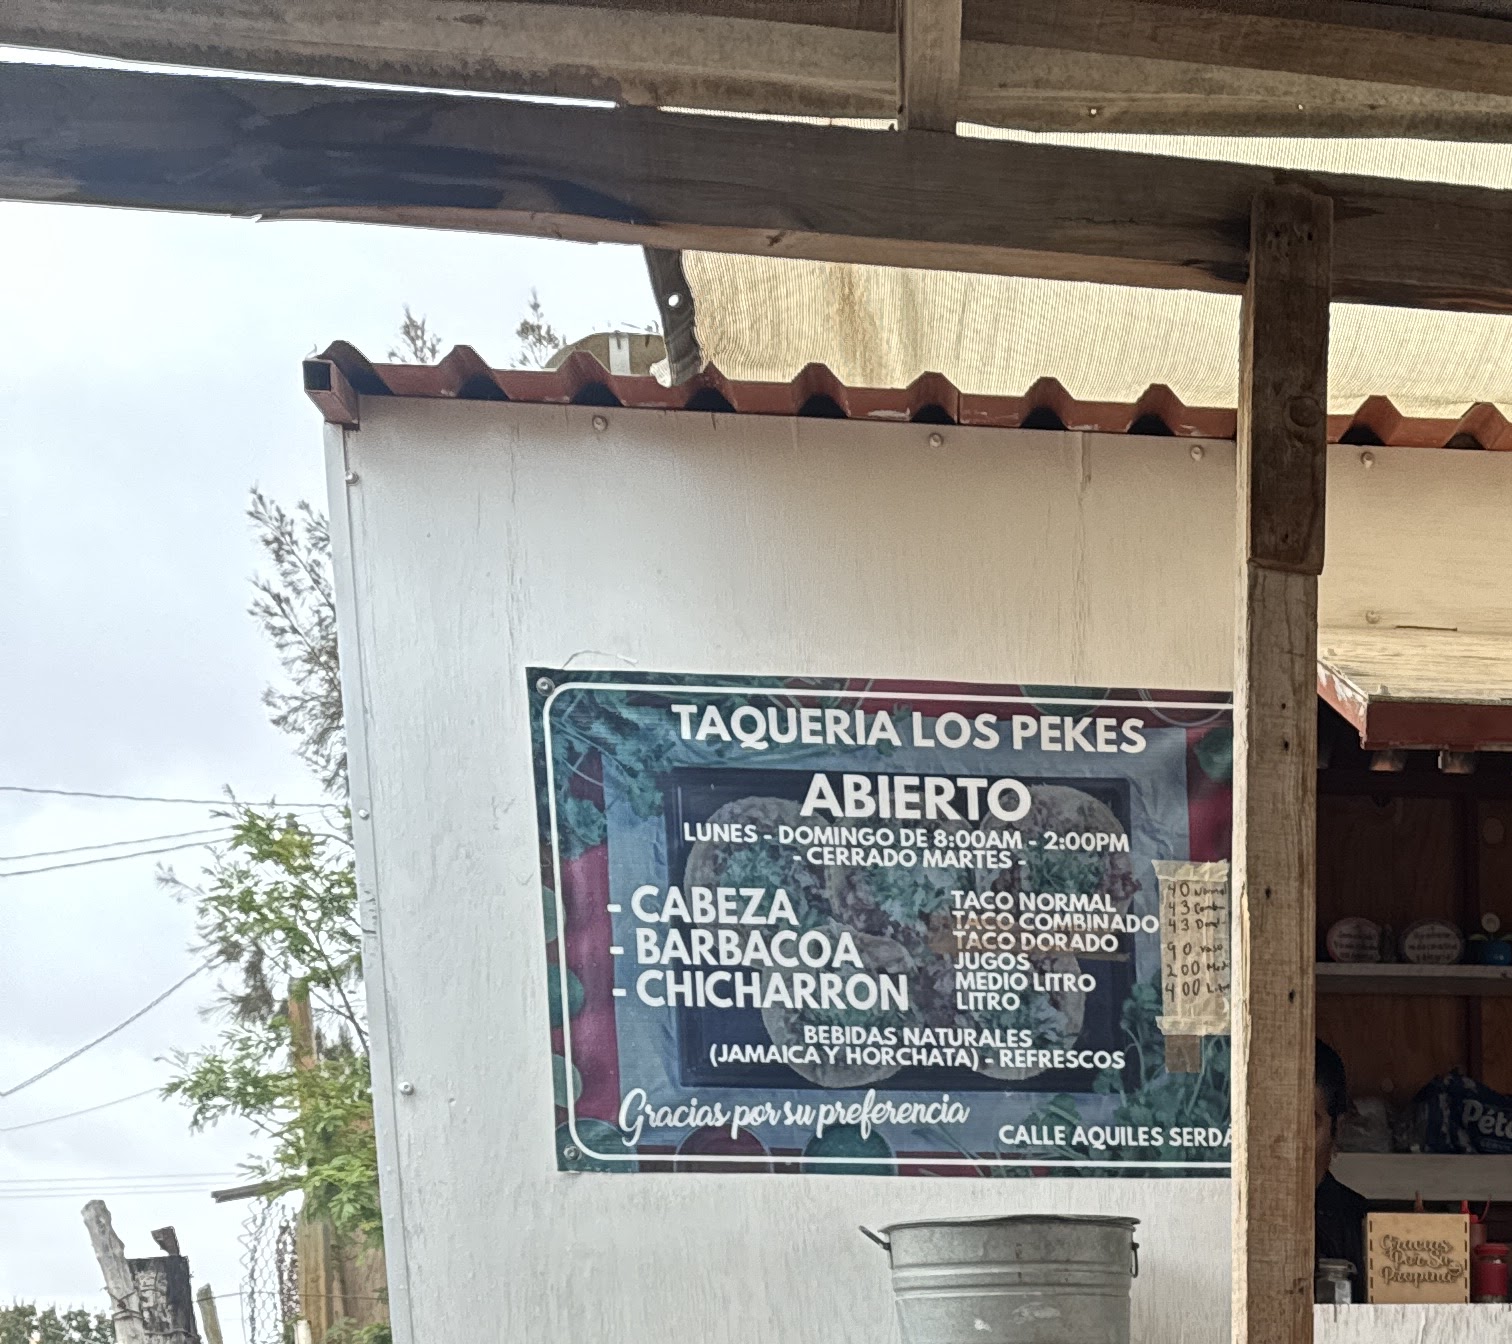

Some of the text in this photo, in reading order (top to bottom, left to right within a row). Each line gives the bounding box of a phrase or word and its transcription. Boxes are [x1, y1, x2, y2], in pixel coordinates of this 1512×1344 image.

[671, 703, 1147, 753] TAQUERIA LOS PEKES
[800, 773, 1031, 822] ABIERTO
[684, 822, 758, 843] LUNES
[778, 825, 895, 846] DOMINGO
[900, 828, 928, 848] DE
[934, 829, 1023, 849] 8:00AM
[1043, 831, 1130, 852] 2:00PM
[806, 847, 917, 867] CERRADO
[922, 849, 1013, 869] MARTES
[951, 890, 1116, 912] TACO NORMAL
[1167, 881, 1190, 898] 40
[631, 884, 800, 925] CABEZA
[1168, 899, 1190, 917] 43
[952, 910, 1159, 934] TACO COMBINADO
[1168, 918, 1190, 933] 43
[636, 928, 864, 969] BARBACOA
[952, 930, 1119, 952] TACO DORADO
[1167, 941, 1192, 961] 90
[953, 951, 1031, 971] JUGOS
[1166, 960, 1200, 978] 200
[636, 969, 909, 1011] CHICHARRON
[955, 971, 1096, 992] MEDIO LITRO
[1165, 978, 1200, 1003] 400
[956, 992, 1020, 1011] LITRO
[804, 1025, 1032, 1048] BEBIDAS NATURALES
[709, 1043, 821, 1067] (JAMAICA
[822, 1046, 838, 1064] Y
[846, 1047, 979, 1069] HORCHATA)
[999, 1050, 1126, 1070] REFRESCOS
[618, 1087, 970, 1147] Gracias por su preferencia
[999, 1122, 1232, 1150] CALLE AQUILES SERDÁ
[1380, 1234, 1454, 1254] Gracias
[1379, 1266, 1458, 1289] Propina
